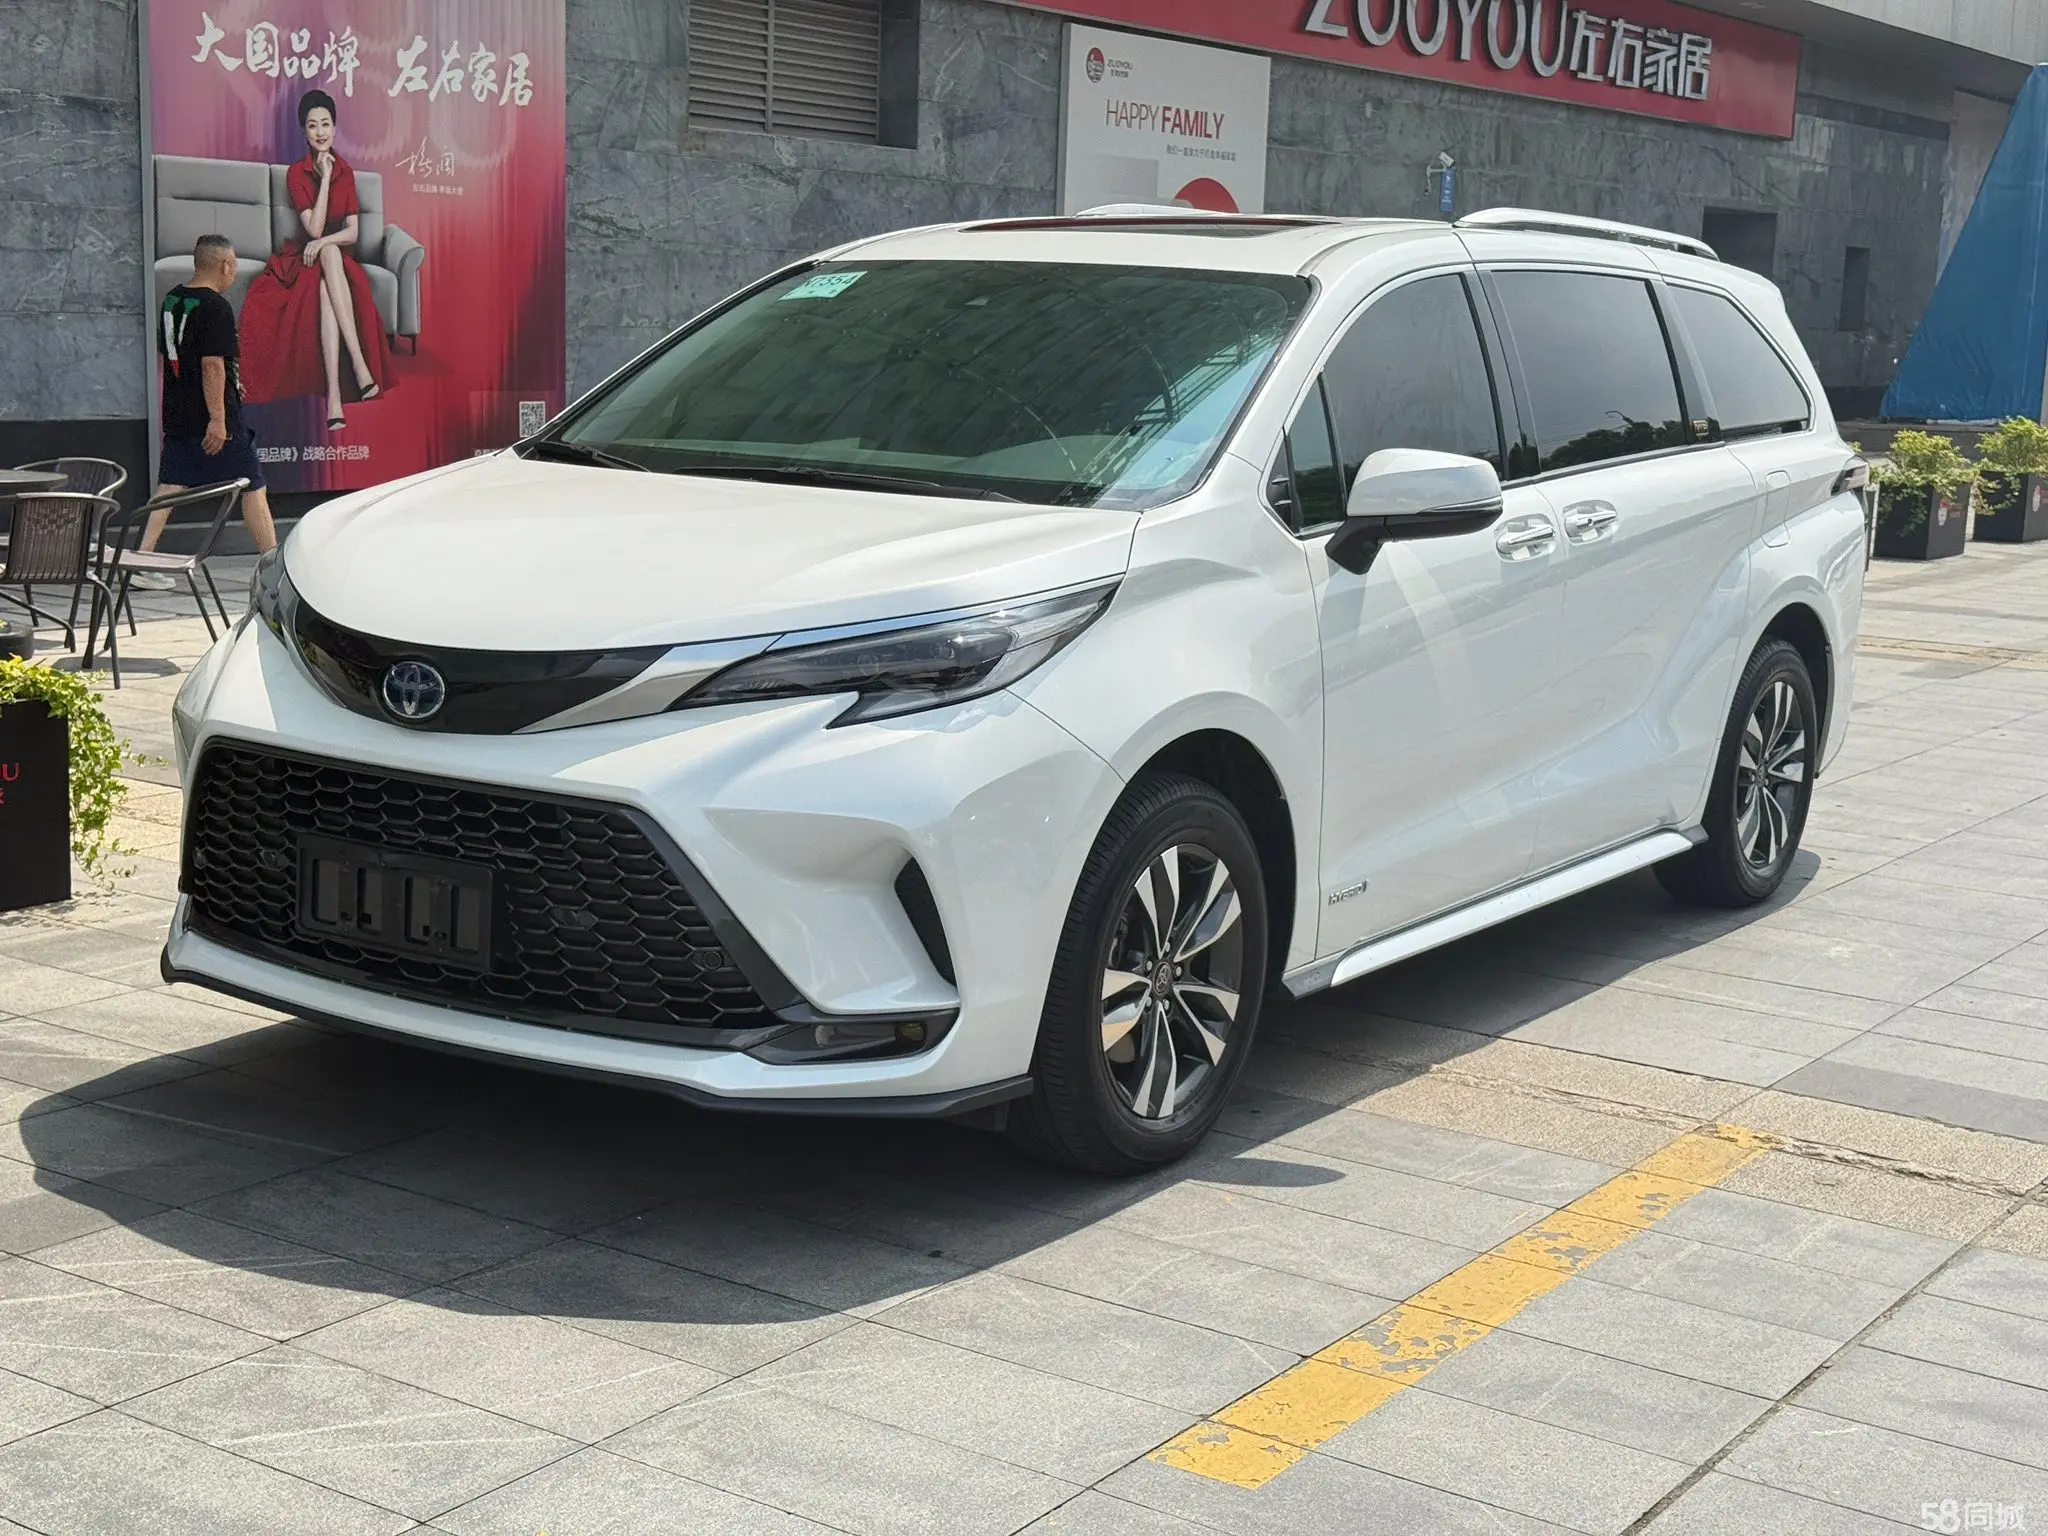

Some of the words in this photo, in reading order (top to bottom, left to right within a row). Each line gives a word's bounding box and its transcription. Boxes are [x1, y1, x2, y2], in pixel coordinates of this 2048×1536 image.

[191, 11, 361, 98] 大国品牌
[388, 35, 534, 107] 左右家居
[1569, 9, 1712, 101] 左右家居
[1105, 98, 1160, 131] HAPPY
[1161, 105, 1225, 140] FAMILY
